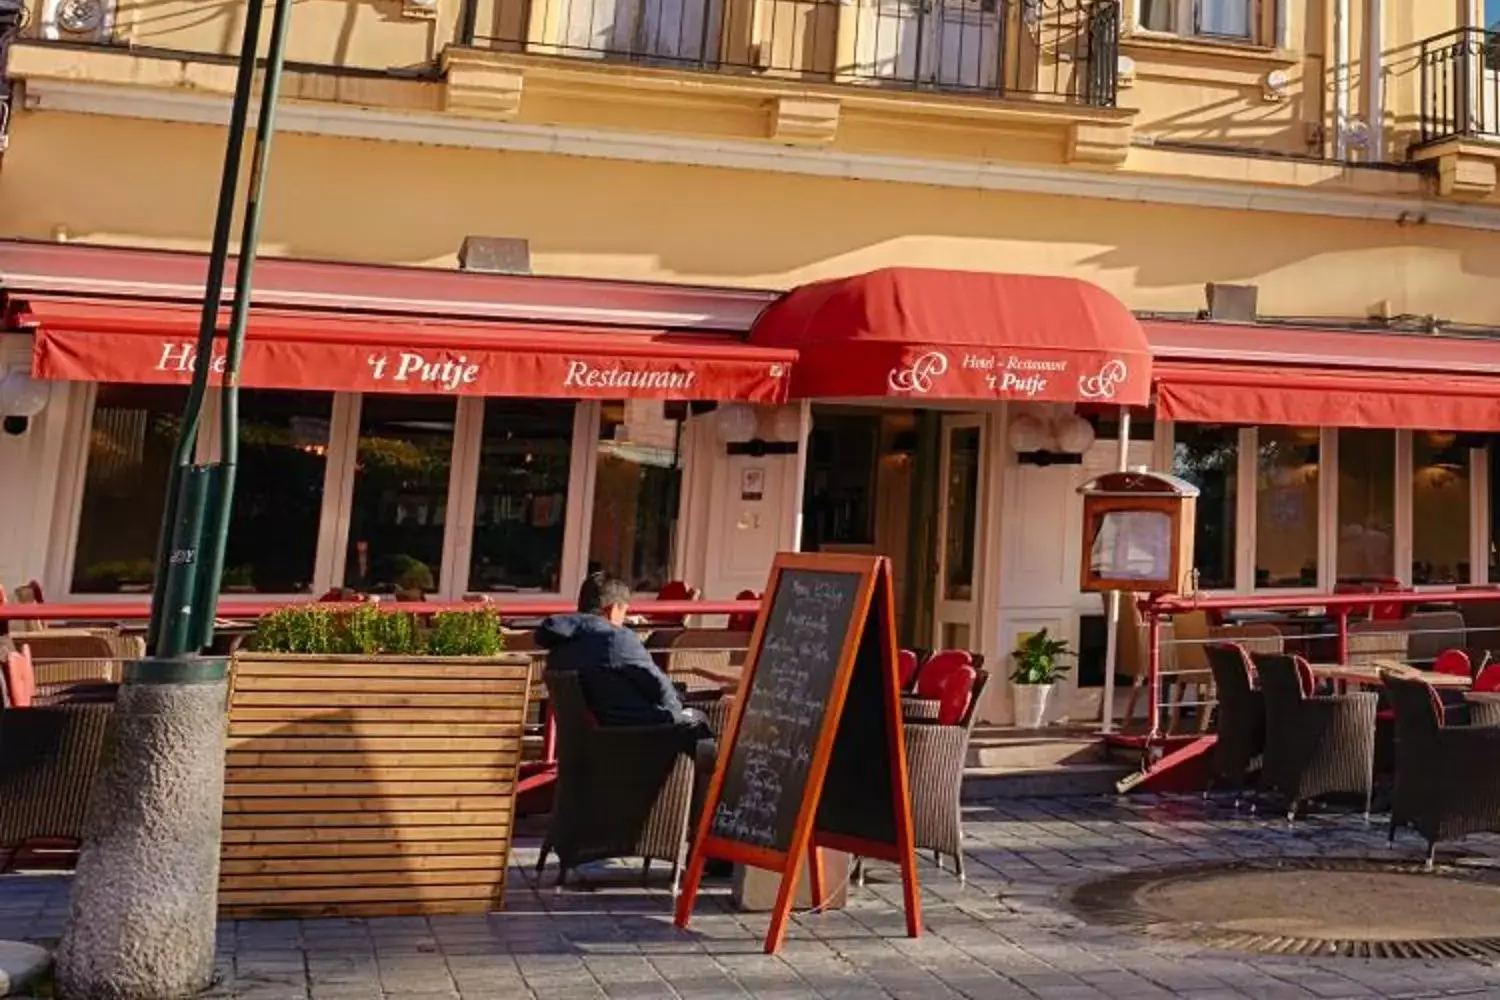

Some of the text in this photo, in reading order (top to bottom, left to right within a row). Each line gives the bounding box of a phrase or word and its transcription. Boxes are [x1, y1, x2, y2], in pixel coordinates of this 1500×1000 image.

[394, 352, 480, 390] Putje
[563, 360, 697, 389] Restaurant
[962, 353, 994, 369] Hotel
[1006, 355, 1067, 372] Restaurant
[1002, 372, 1048, 396] Putje
